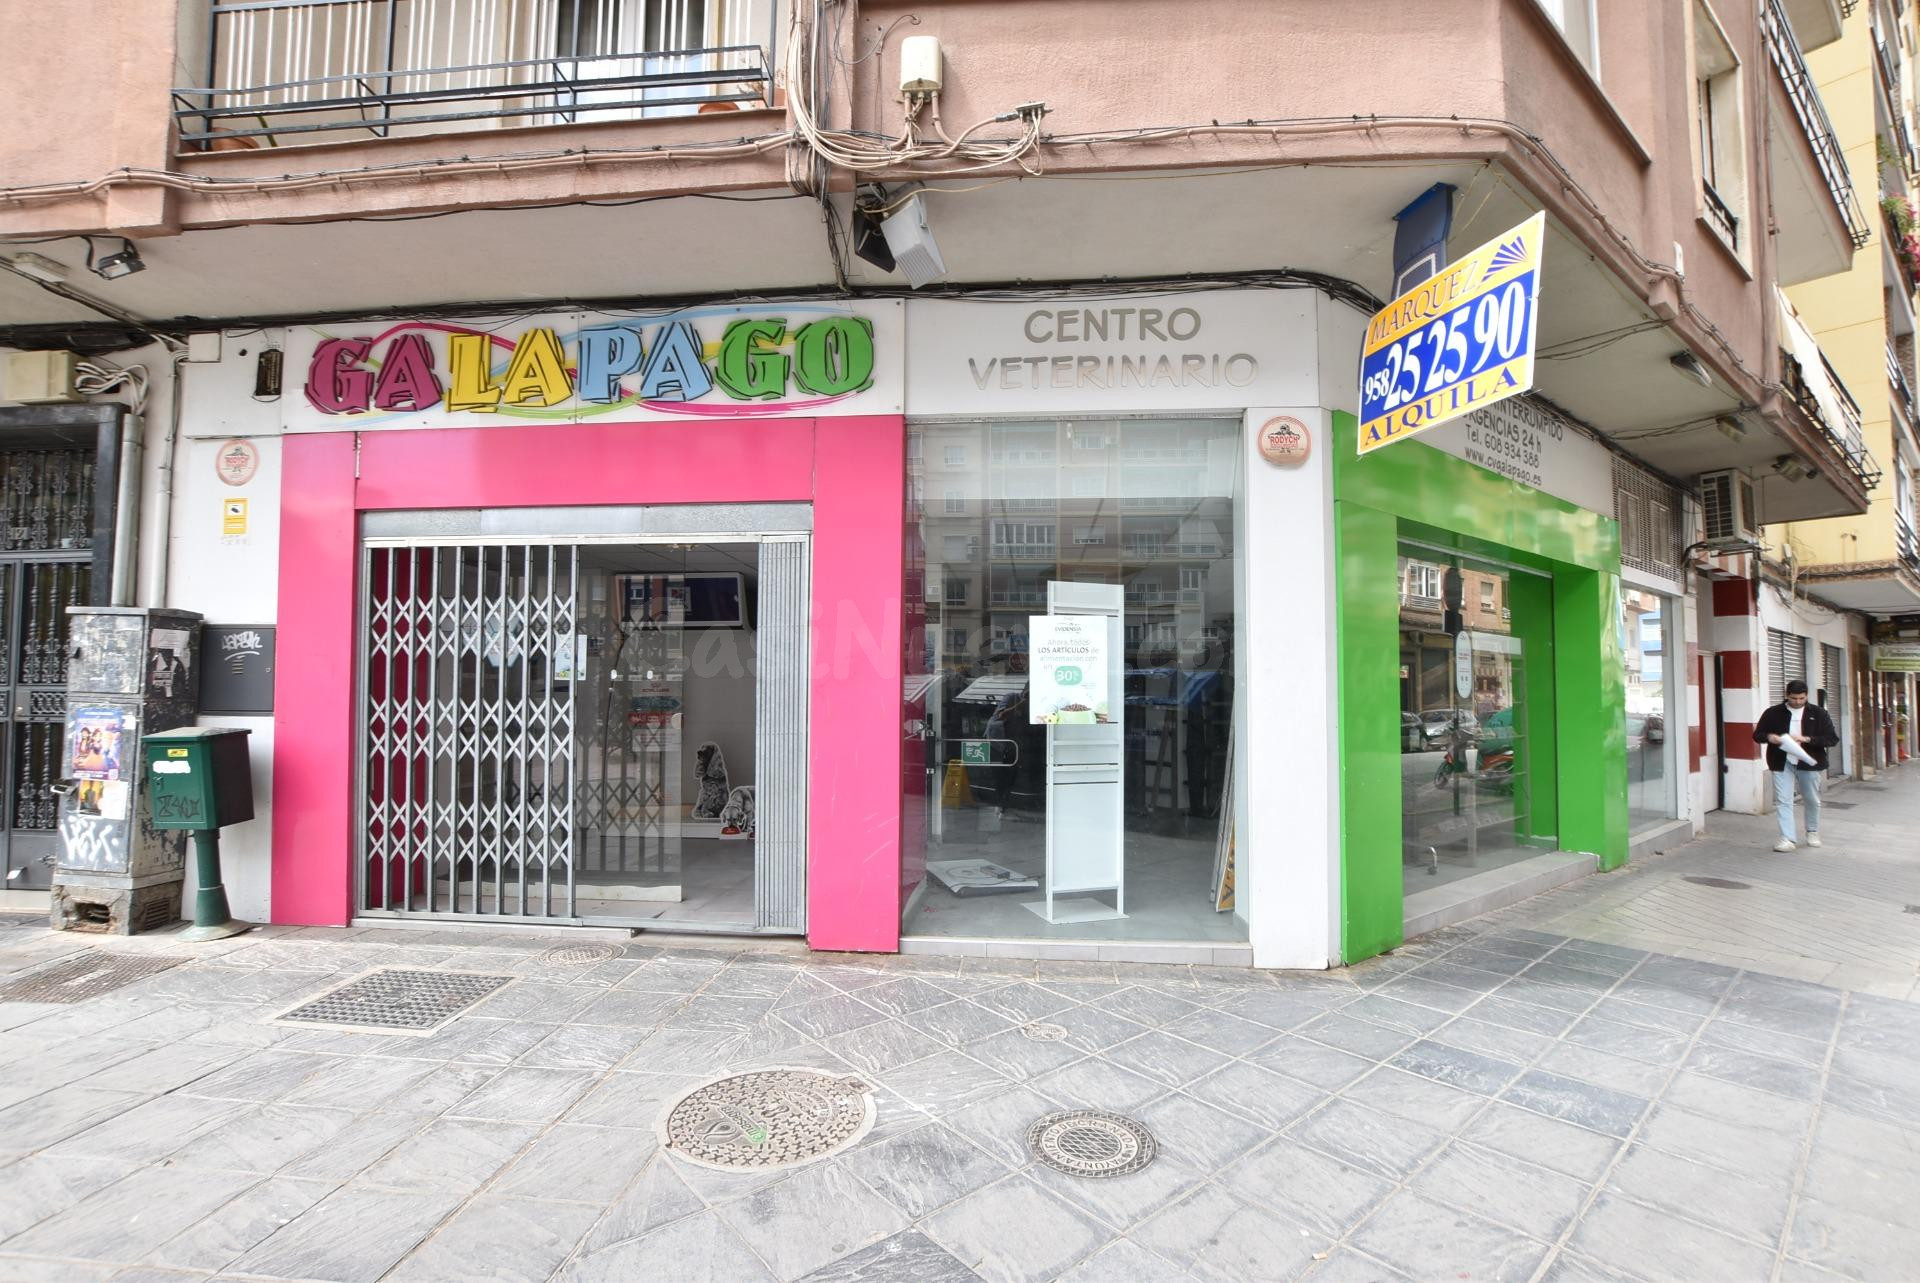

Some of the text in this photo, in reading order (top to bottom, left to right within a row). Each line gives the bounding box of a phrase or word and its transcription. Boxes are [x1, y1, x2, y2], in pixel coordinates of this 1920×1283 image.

[1024, 307, 1202, 343] CENTRO
[304, 317, 875, 415] GALAPAGO
[968, 353, 1259, 390] VETERINARIO
[1365, 368, 1390, 404] 958
[1365, 366, 1518, 446] ALQUILA
[1462, 409, 1520, 442] RGENCIAS
[1522, 429, 1534, 450] 24
[1465, 424, 1481, 445] Tel.
[1038, 646, 1050, 654] LOS
